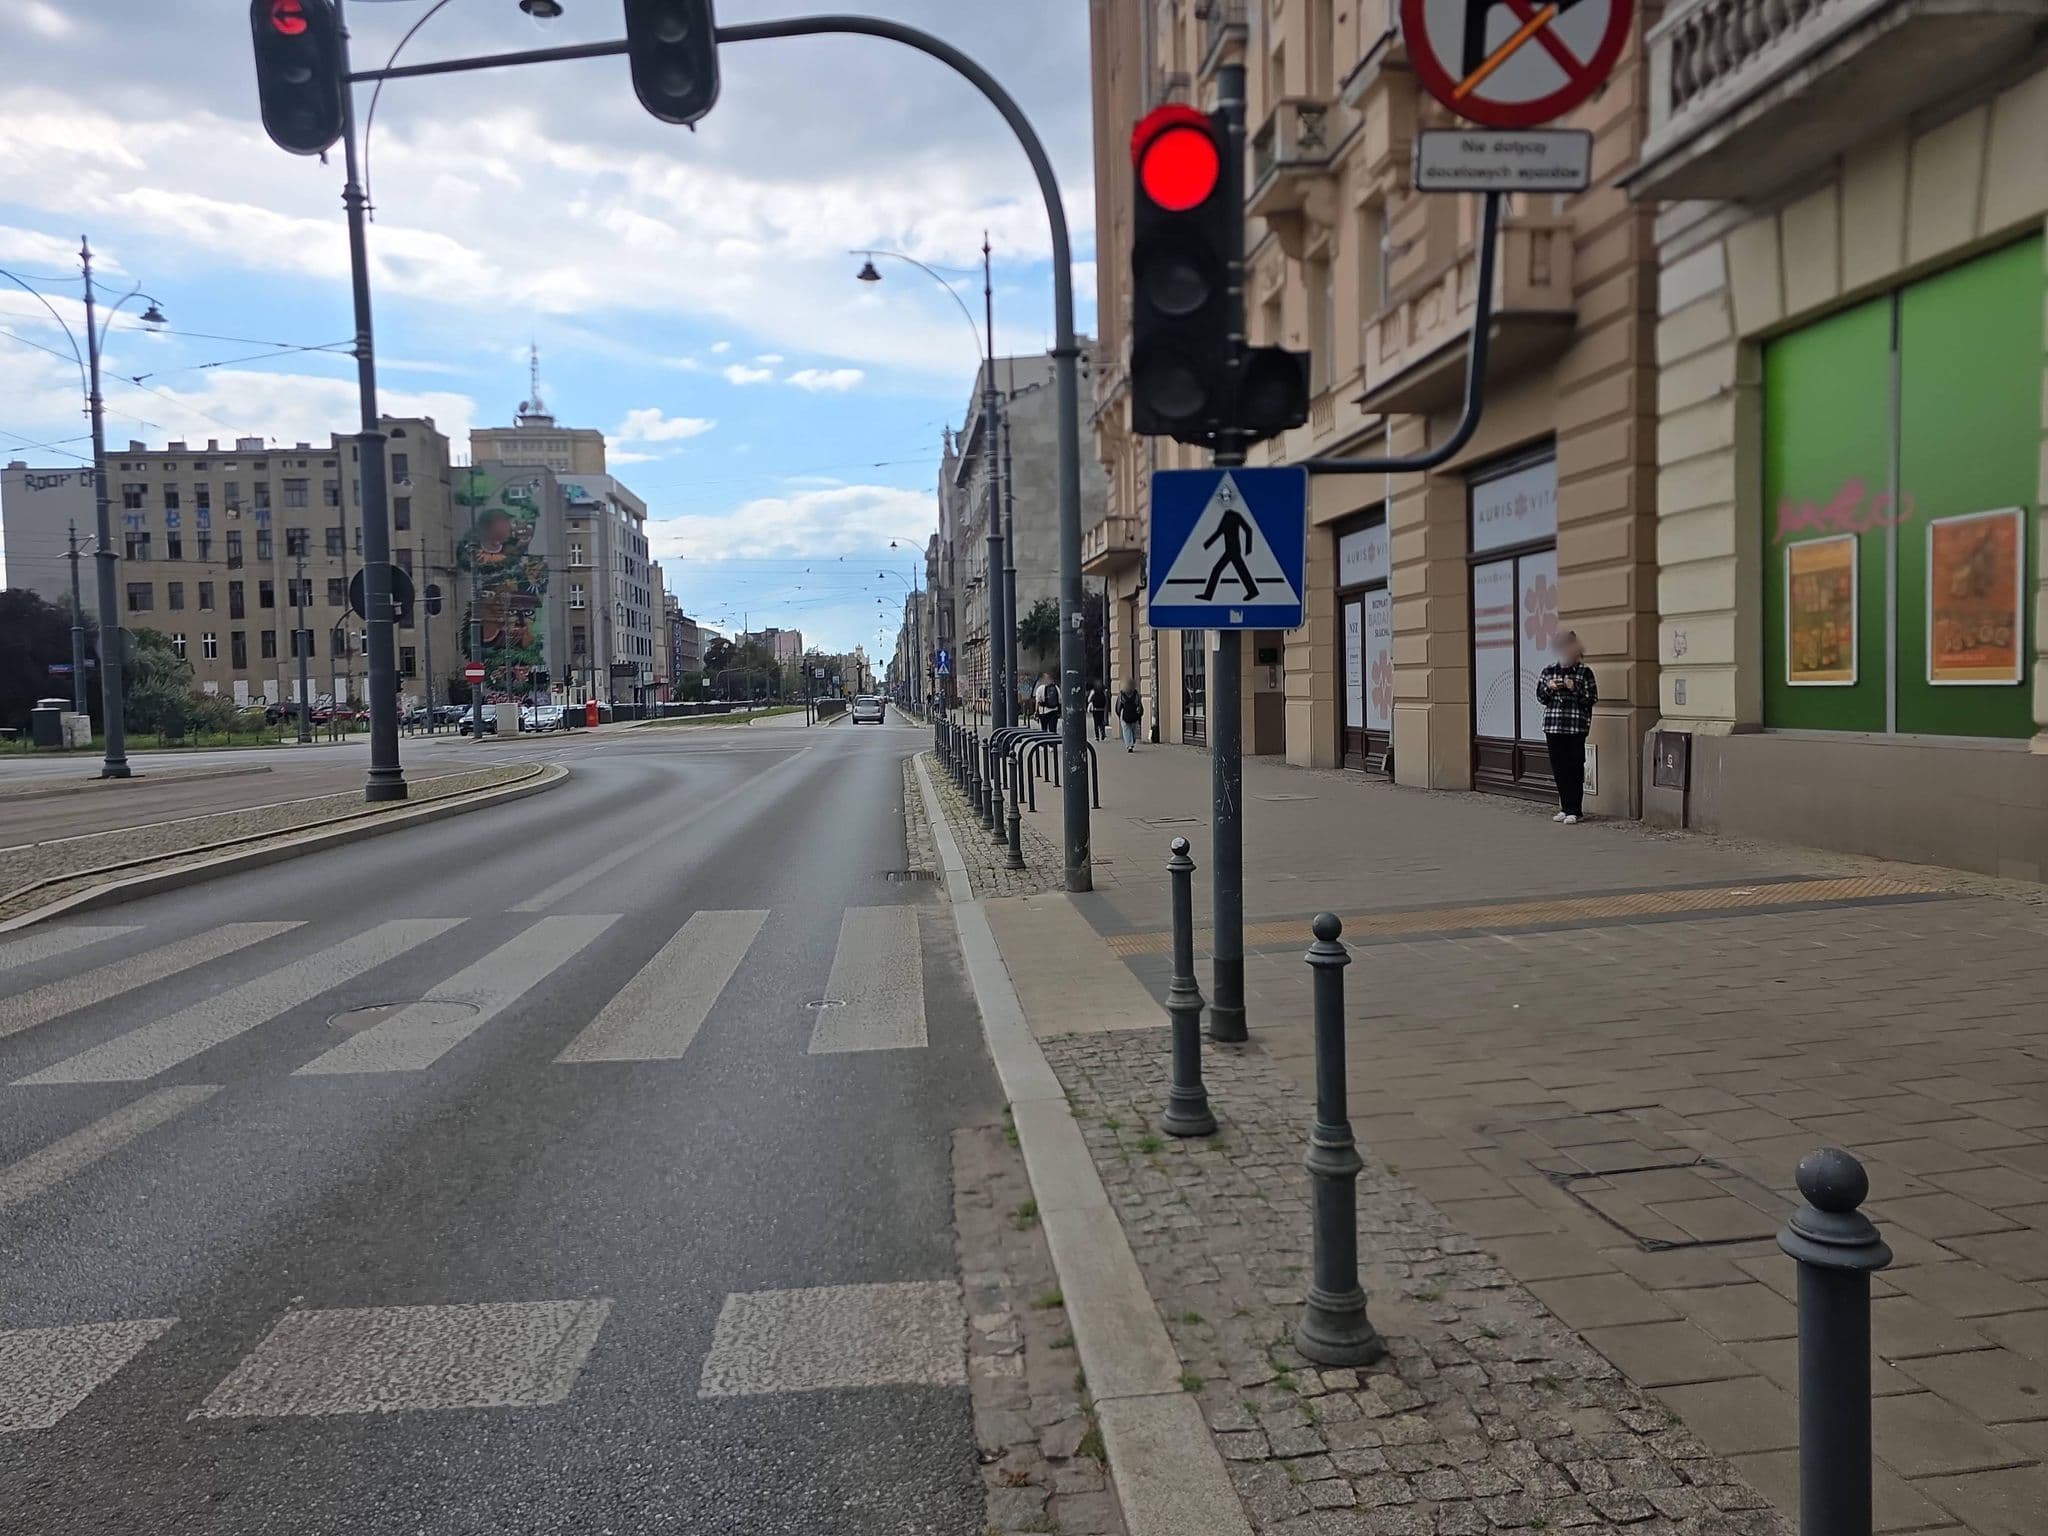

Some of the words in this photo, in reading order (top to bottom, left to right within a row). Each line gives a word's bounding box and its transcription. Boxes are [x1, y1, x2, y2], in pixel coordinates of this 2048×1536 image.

[1462, 138, 1486, 152] Nie
[1493, 139, 1546, 156] dotyczy
[24, 473, 71, 492] ROOF
[1478, 500, 1513, 523] AURIS
